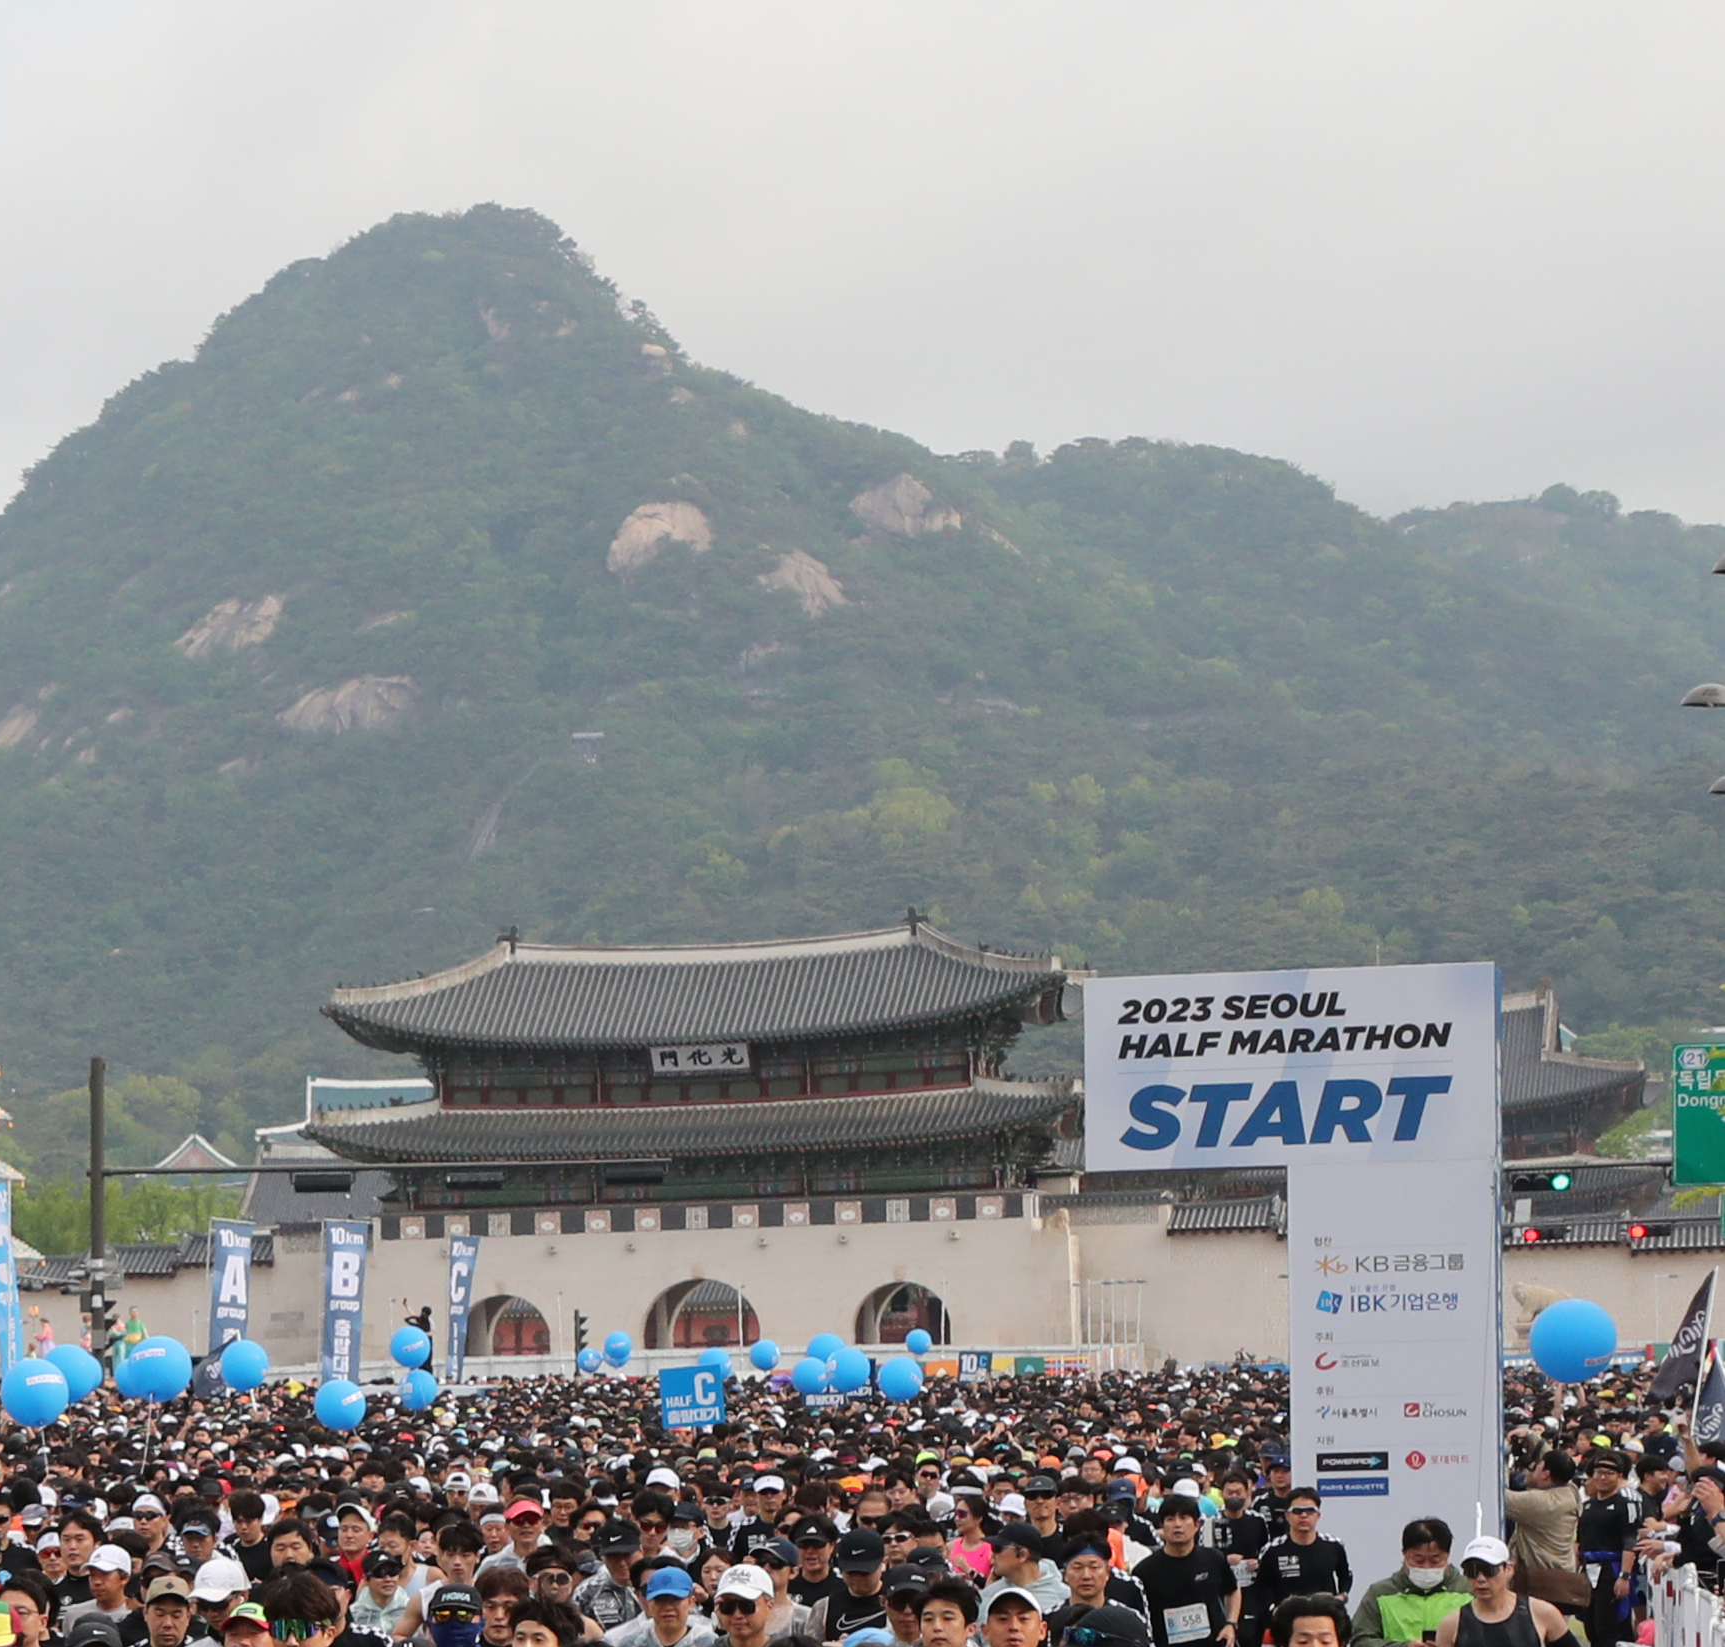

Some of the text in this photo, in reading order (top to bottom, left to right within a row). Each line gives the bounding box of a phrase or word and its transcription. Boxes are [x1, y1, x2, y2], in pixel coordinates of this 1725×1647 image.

[1118, 991, 1348, 1026] 2023 SEOUL
[1117, 1021, 1453, 1060] HALF MARATHON
[1685, 1051, 1705, 1065] 21
[1119, 1074, 1453, 1152] START
[219, 1228, 251, 1249] 10km
[331, 1227, 364, 1246] 10km
[1355, 1253, 1463, 1273] KB금융그룹
[219, 1254, 247, 1305] A
[331, 1252, 360, 1298] B
[451, 1261, 468, 1302] C
[329, 1300, 360, 1314] group
[1350, 1292, 1458, 1313] IBK기업은행
[216, 1306, 246, 1321] group
[1314, 1332, 1334, 1342] 주최
[960, 1354, 978, 1373] 10
[693, 1371, 716, 1405] C
[1315, 1386, 1334, 1396] 후원
[665, 1395, 693, 1409] HALF
[667, 1406, 720, 1425] 출발대기
[1330, 1407, 1378, 1418] 서울특별시
[1422, 1409, 1467, 1417] CHOSUN
[1316, 1436, 1334, 1446] 지원
